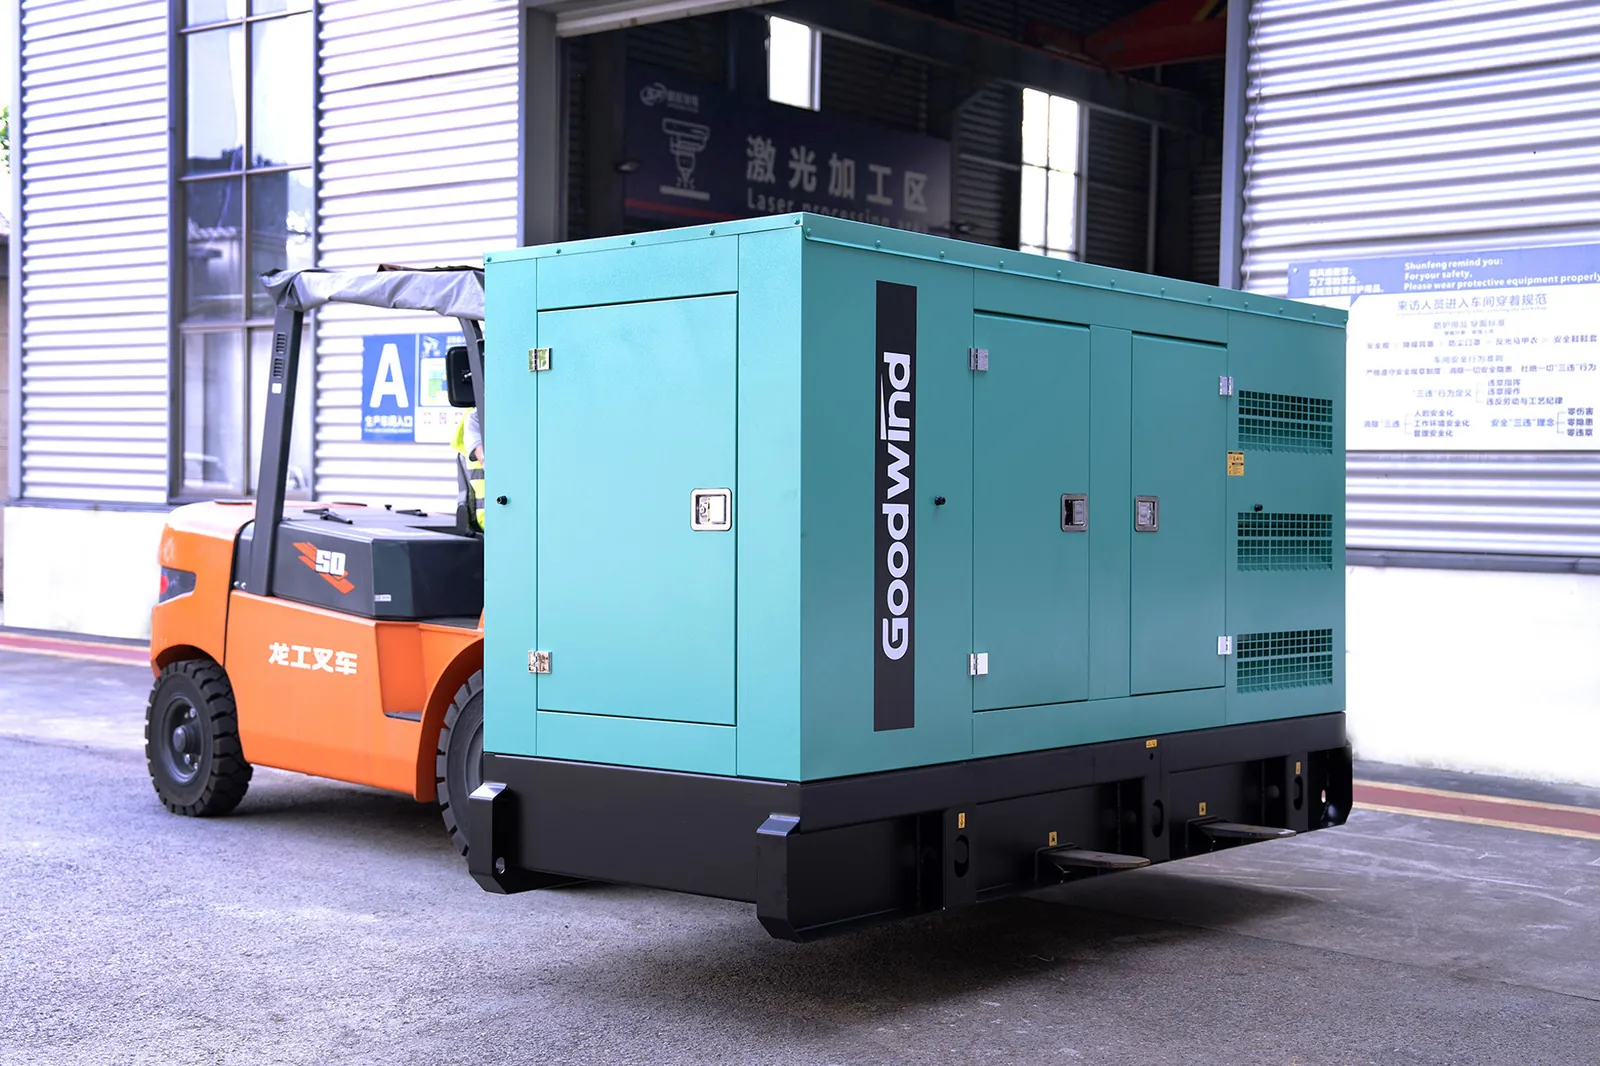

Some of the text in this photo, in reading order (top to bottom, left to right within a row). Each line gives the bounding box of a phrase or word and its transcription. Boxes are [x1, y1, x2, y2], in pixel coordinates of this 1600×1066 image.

[746, 135, 928, 213] 激光加工区
[747, 188, 796, 213] Laser
[1404, 258, 1503, 271] Shunfeng remind you:
[1404, 282, 1433, 291] Please
[1433, 282, 1456, 290] wear
[1457, 278, 1504, 290] protective
[1506, 275, 1558, 286] equipment
[369, 343, 409, 408] A
[880, 352, 911, 661] Goodwind
[268, 641, 358, 676] 龙工叉车
